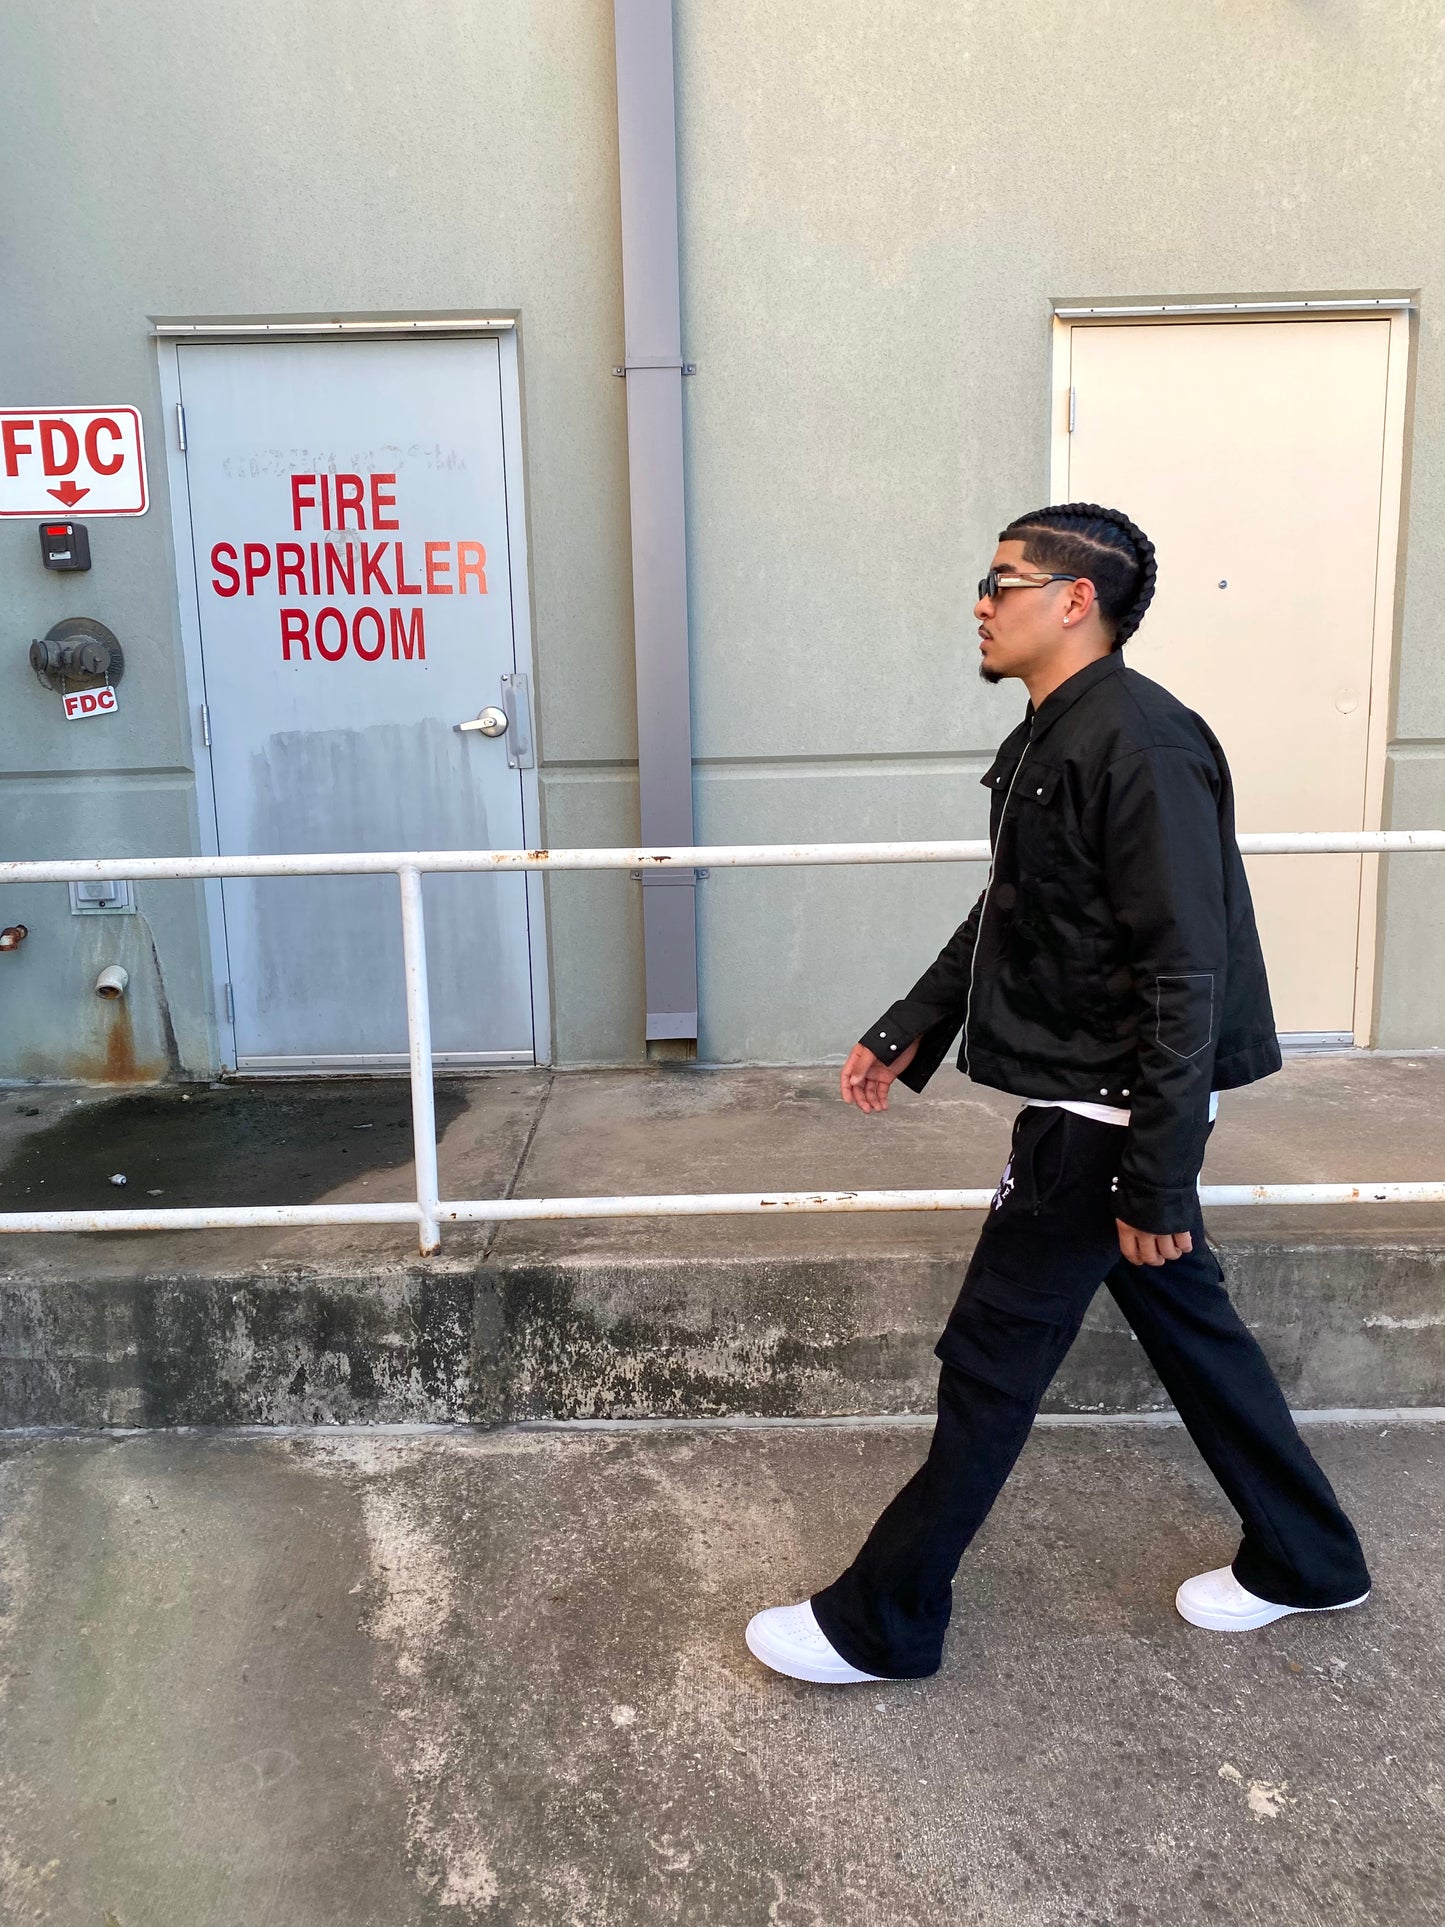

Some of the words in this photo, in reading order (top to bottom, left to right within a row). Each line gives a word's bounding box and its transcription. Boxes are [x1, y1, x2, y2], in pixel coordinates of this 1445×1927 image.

[1, 417, 125, 477] FDC
[290, 473, 400, 531] FIRE
[210, 541, 489, 598] SPRINKLER
[279, 606, 427, 662] ROOM
[64, 690, 116, 716] FDC
